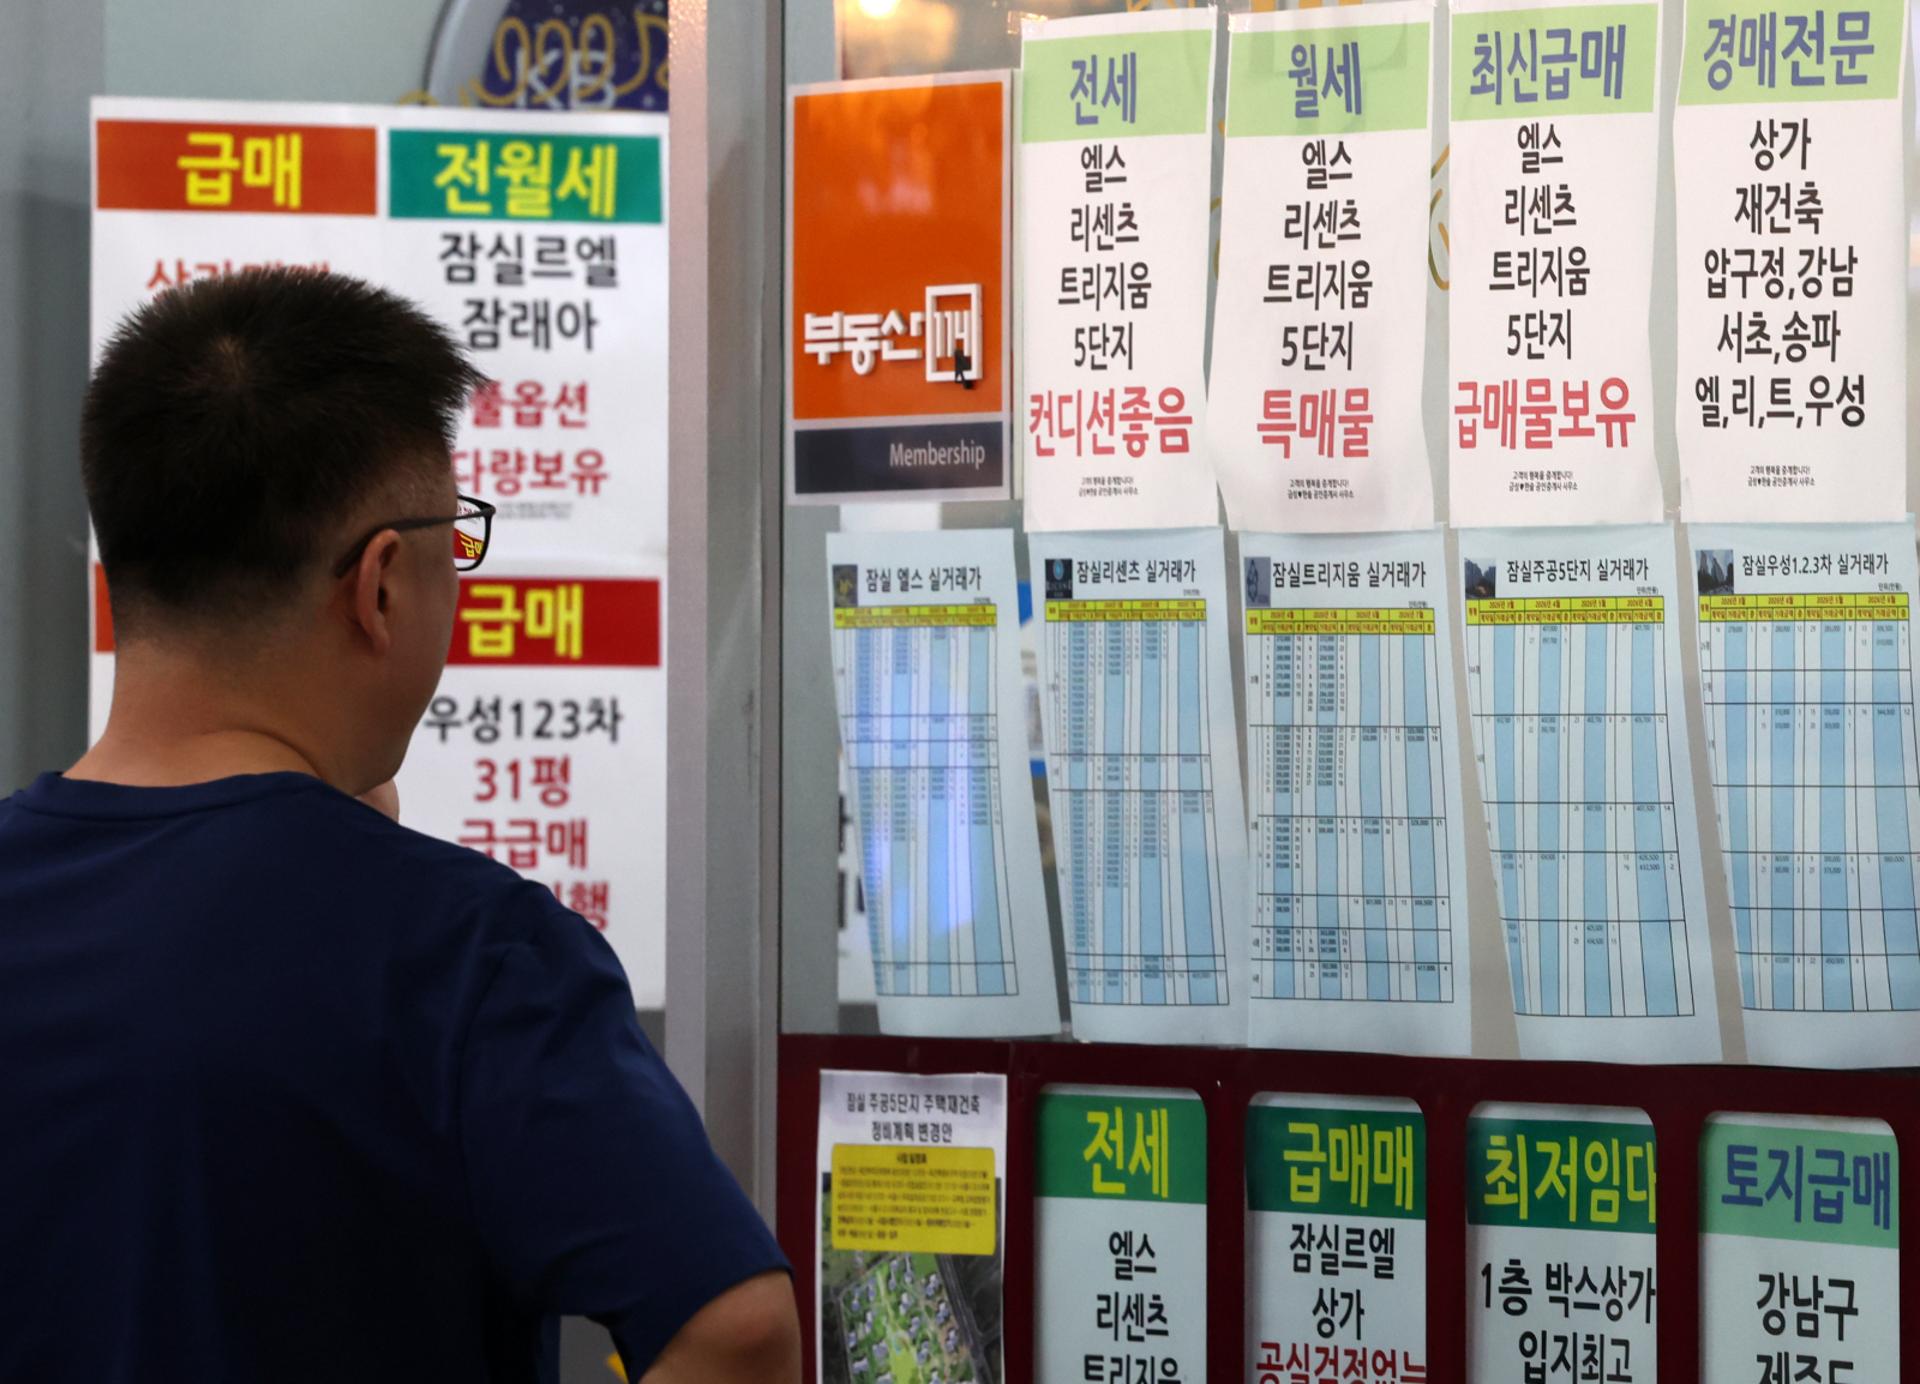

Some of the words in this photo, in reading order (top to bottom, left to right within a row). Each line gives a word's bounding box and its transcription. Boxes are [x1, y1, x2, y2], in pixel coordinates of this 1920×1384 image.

[1470, 25, 1627, 105] 최신급매
[1704, 11, 1875, 91] 경매전문
[1070, 52, 1137, 126] 전세
[1289, 42, 1361, 118] 월세
[178, 131, 302, 209] 급매
[1081, 144, 1127, 193] 엘스
[1301, 140, 1352, 190] 엘스
[1517, 123, 1564, 174] 엘스
[1750, 118, 1812, 171] 상가
[434, 142, 617, 219] 전월세
[1071, 203, 1139, 252] 리센츠
[1284, 201, 1361, 250] 리센츠
[1505, 183, 1577, 236] 리센츠
[1734, 182, 1823, 235] 재건축
[439, 233, 618, 288] 잠실르엘
[1058, 262, 1151, 311] 트리지움
[1264, 260, 1373, 310] 트리지움
[1489, 246, 1590, 298] 트리지움
[1704, 247, 1858, 301] 압구정,강남
[461, 299, 598, 352] 잠래아
[1074, 322, 1133, 371] 5단지
[1282, 322, 1353, 371] 5단지
[1507, 309, 1573, 360] 5단지
[1718, 311, 1841, 364] 서초,송파
[470, 380, 588, 428] 풀옵션
[1030, 386, 1193, 459] 컨디션좋음
[1257, 387, 1374, 459] 특매물
[1454, 378, 1636, 450] 급매물보유
[1695, 375, 1866, 430] 엘,리,트,우성
[452, 449, 609, 497] 다량보유
[890, 441, 985, 468] Membership
[866, 568, 891, 593] 잠실
[897, 567, 923, 592] 엘스
[929, 566, 982, 591] 실거래가
[1077, 560, 1139, 583] 잠실리센츠
[1146, 559, 1196, 583] 실거래가
[1273, 562, 1360, 587] 잠실트리지움
[1367, 561, 1426, 587] 실거래가
[1507, 559, 1591, 582] 잠실주공5단지
[1597, 558, 1648, 581] 실거래가
[1742, 555, 1832, 576] 잠실우성1.2.3차
[1838, 553, 1888, 575] 실거래가
[460, 584, 584, 659] 급매
[424, 696, 623, 743] 우성123차
[475, 756, 572, 808] 31평
[870, 1093, 919, 1114] 주공5단지
[924, 1094, 980, 1114] 주택재건축
[872, 1121, 914, 1141] 정비계획
[919, 1122, 952, 1142] 변경안
[1083, 1106, 1169, 1199] 전세
[1283, 1122, 1413, 1211] 급매매
[1722, 1144, 1890, 1229] 토지급매
[1109, 1231, 1157, 1281] 엘스
[1290, 1223, 1394, 1279] 잠실르엘
[1312, 1287, 1364, 1340] 상가
[1481, 1259, 1532, 1316] 1층
[1546, 1262, 1656, 1323] 박스상가
[1756, 1273, 1859, 1341] 강남구
[1097, 1293, 1169, 1343] 리센츠
[1519, 1330, 1632, 1384] 입지최고
